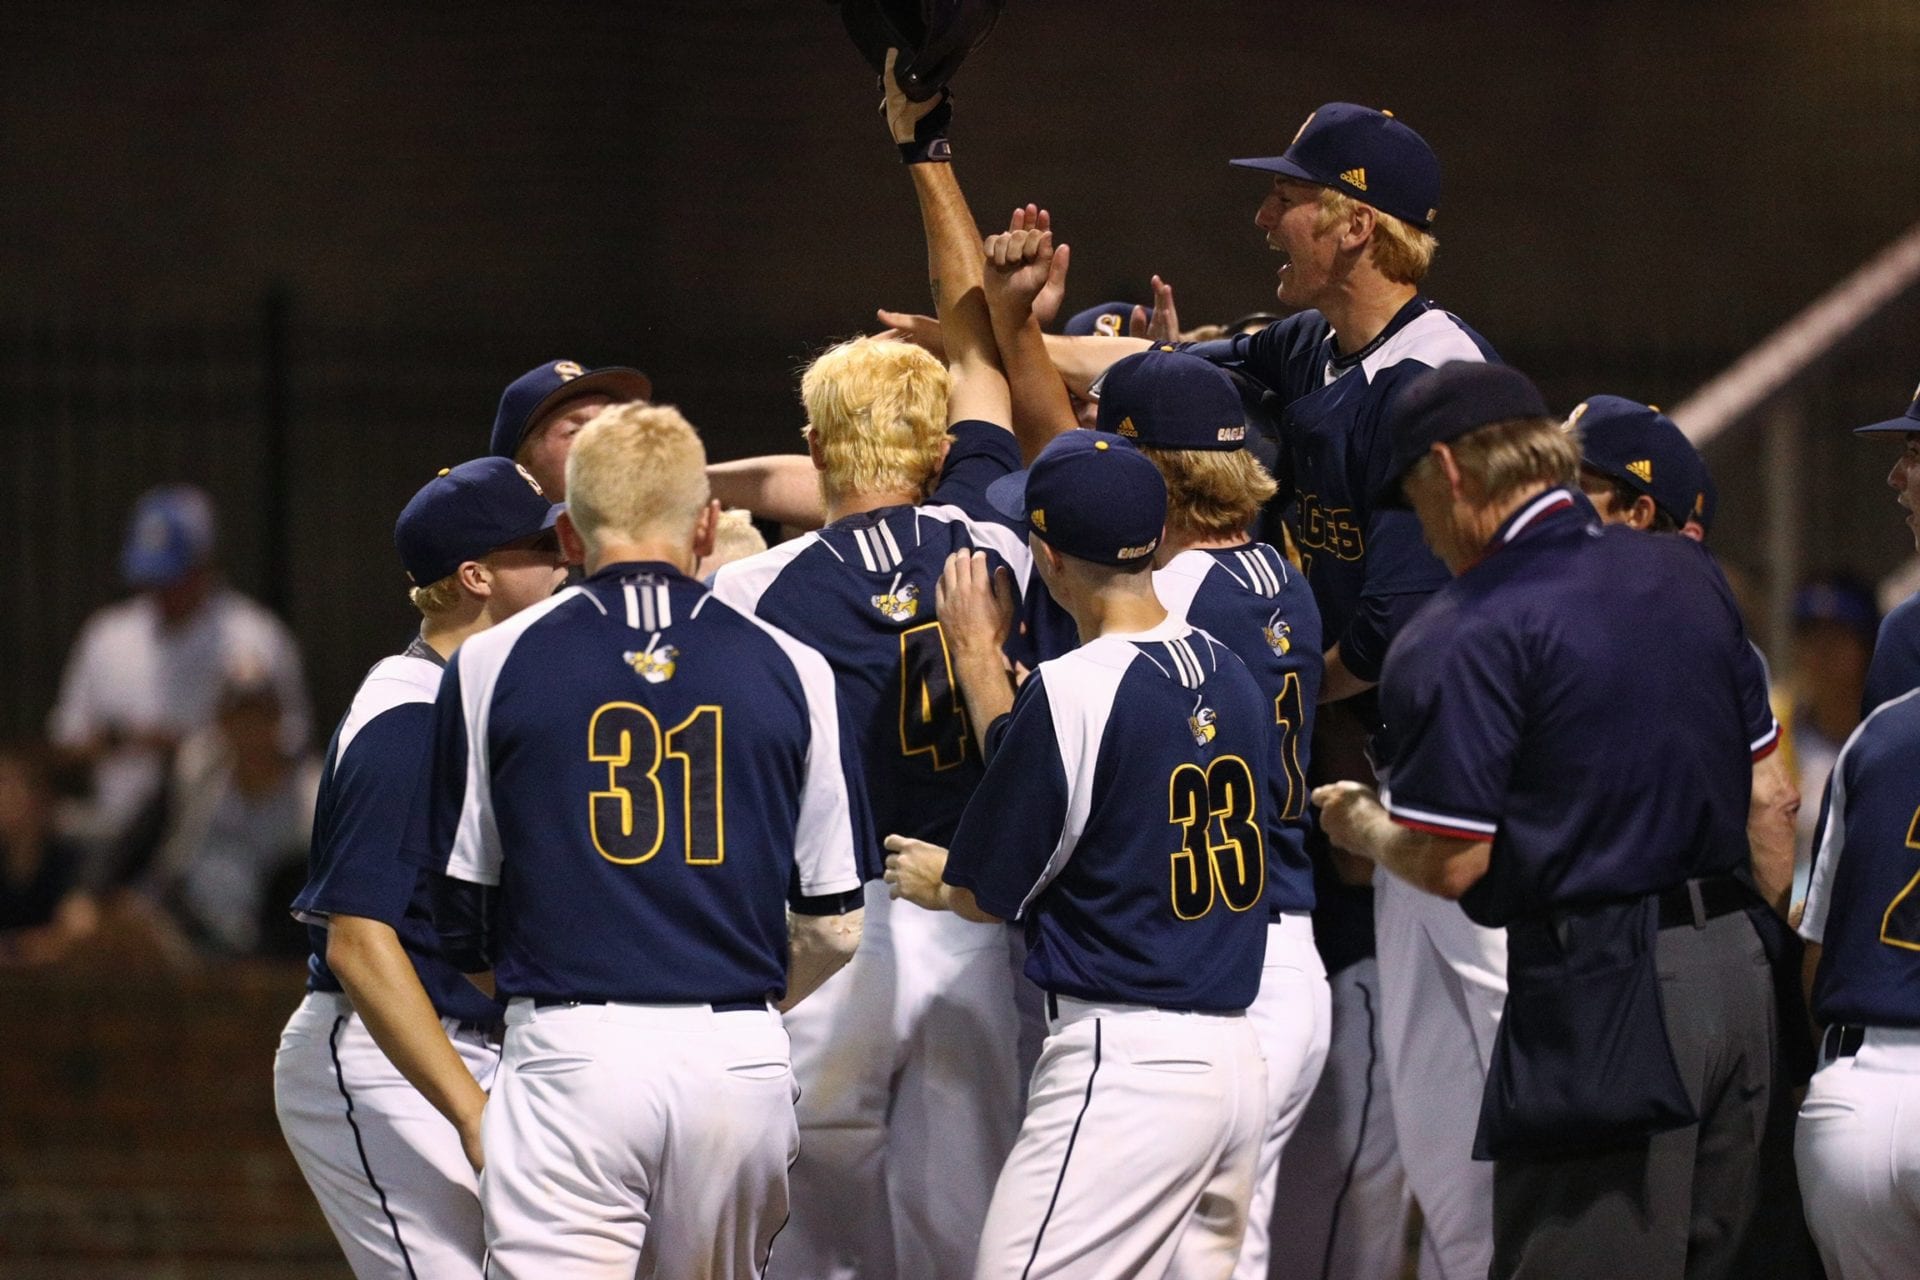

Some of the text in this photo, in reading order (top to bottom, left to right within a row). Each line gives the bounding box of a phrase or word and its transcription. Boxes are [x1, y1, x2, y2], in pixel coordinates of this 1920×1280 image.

[900, 621, 967, 772] 4
[1274, 672, 1306, 821] 1
[588, 701, 724, 865] 31
[1169, 754, 1265, 920] 33
